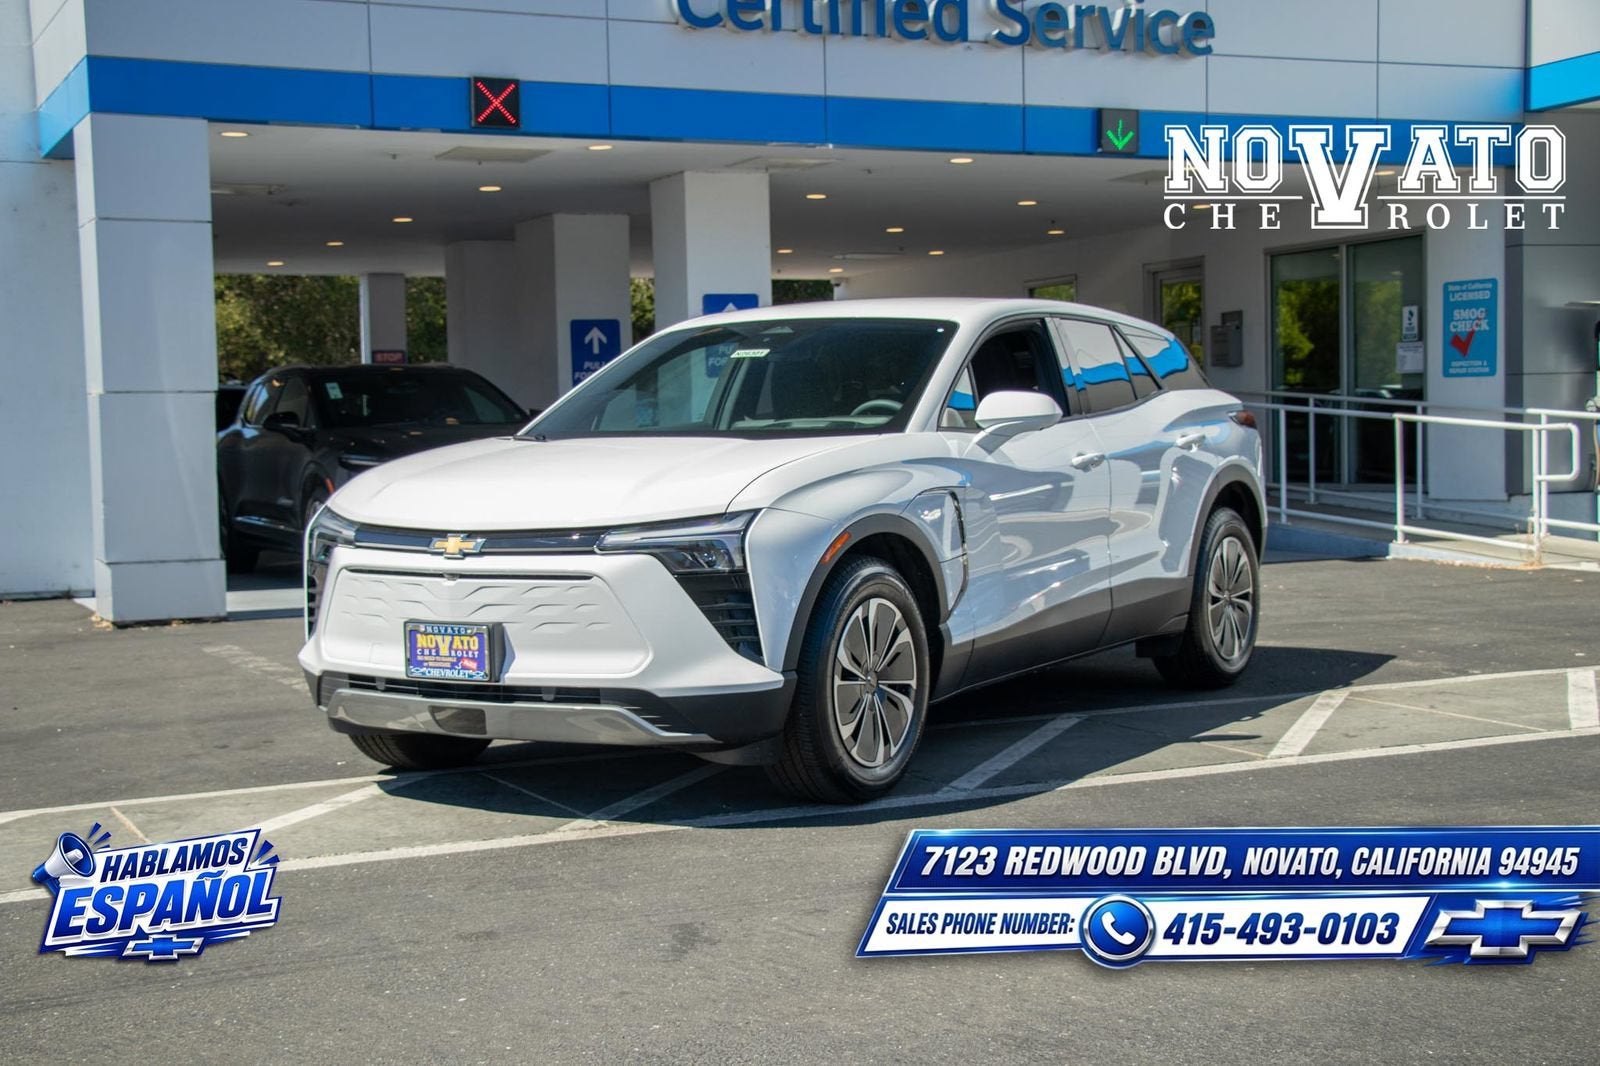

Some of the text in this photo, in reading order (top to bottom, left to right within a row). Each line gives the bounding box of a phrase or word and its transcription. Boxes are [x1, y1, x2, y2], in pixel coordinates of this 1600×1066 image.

[995, 0, 1215, 56] Service
[1449, 290, 1491, 301] LICENSED
[1453, 308, 1486, 320] SMOG
[1449, 320, 1489, 332] CHECK
[426, 625, 466, 634] NOVATO
[416, 634, 478, 656] NOVATO
[426, 667, 468, 679] CHEVROLET
